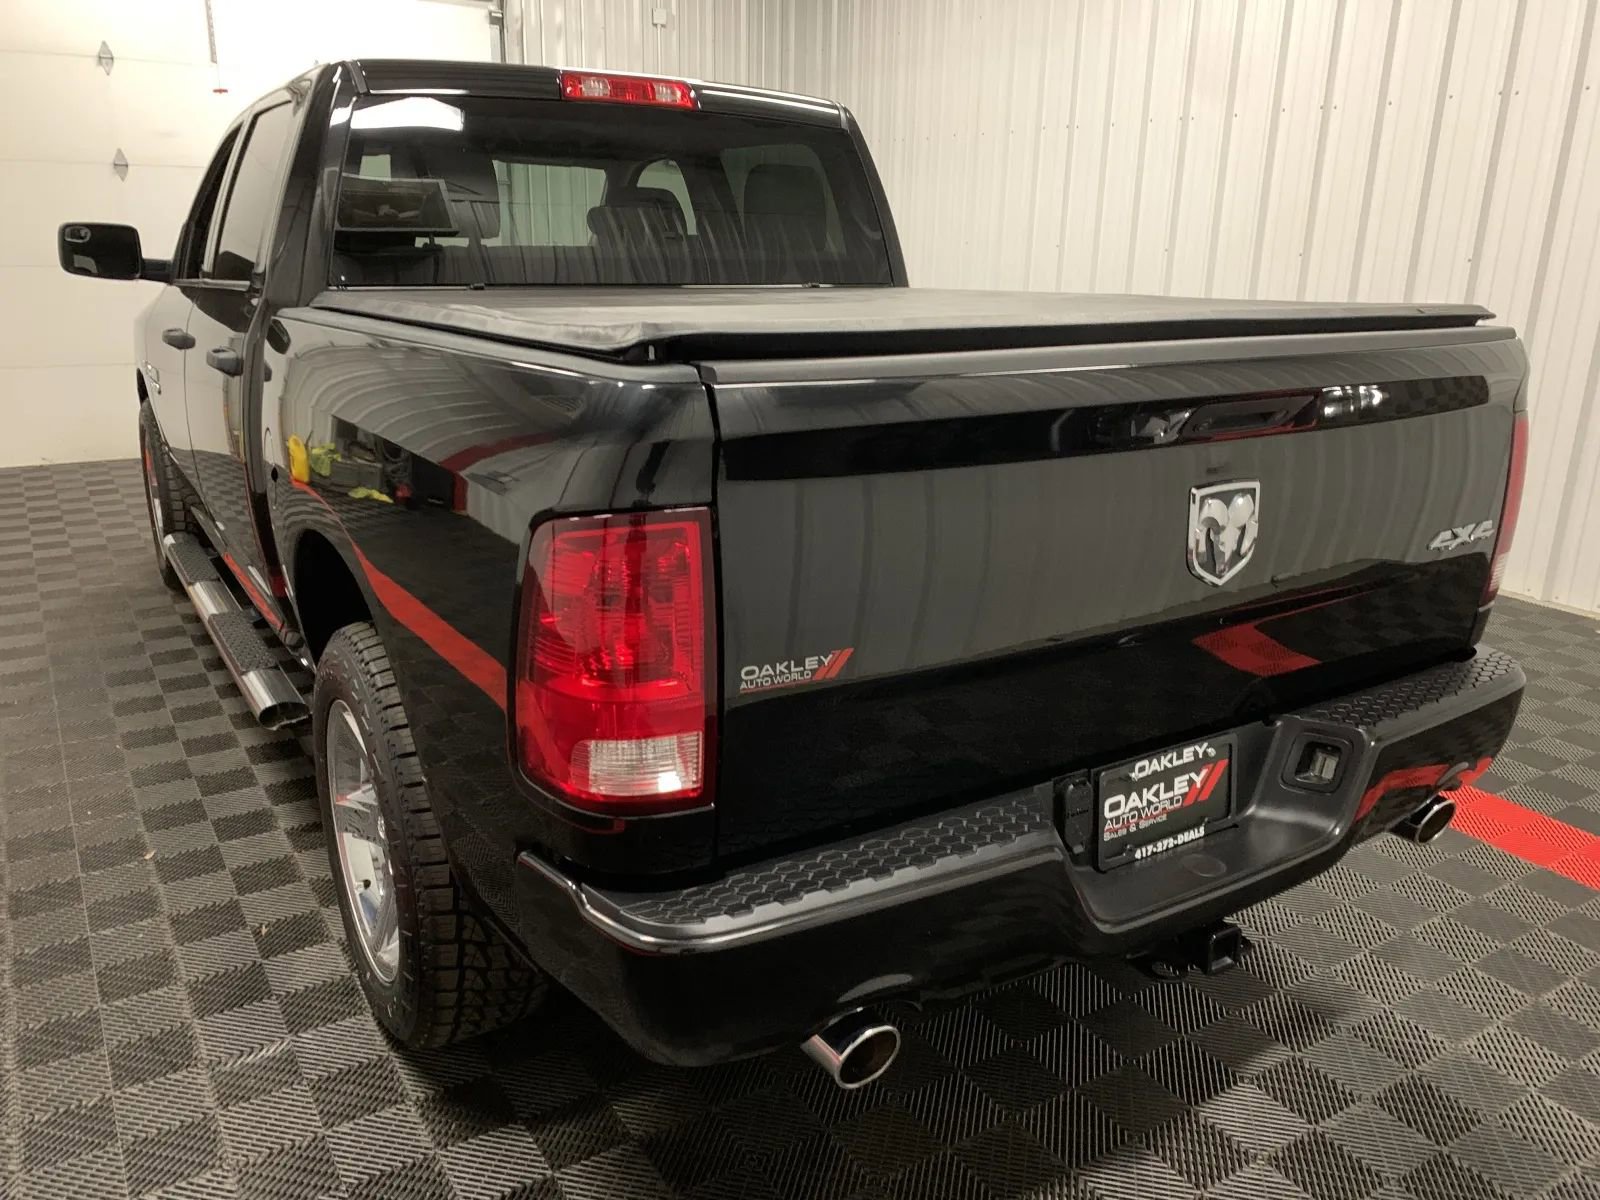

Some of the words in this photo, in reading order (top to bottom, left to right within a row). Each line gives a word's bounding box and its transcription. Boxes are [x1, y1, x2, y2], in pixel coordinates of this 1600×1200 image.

[739, 677, 771, 690] AUTO
[773, 670, 812, 685] WORLD
[740, 654, 833, 680] OAKLEY
[1134, 742, 1209, 779] OAKLEY
[1103, 768, 1209, 819] OAKLEY
[1104, 811, 1139, 831] AUTO
[1140, 795, 1183, 819] WORLD
